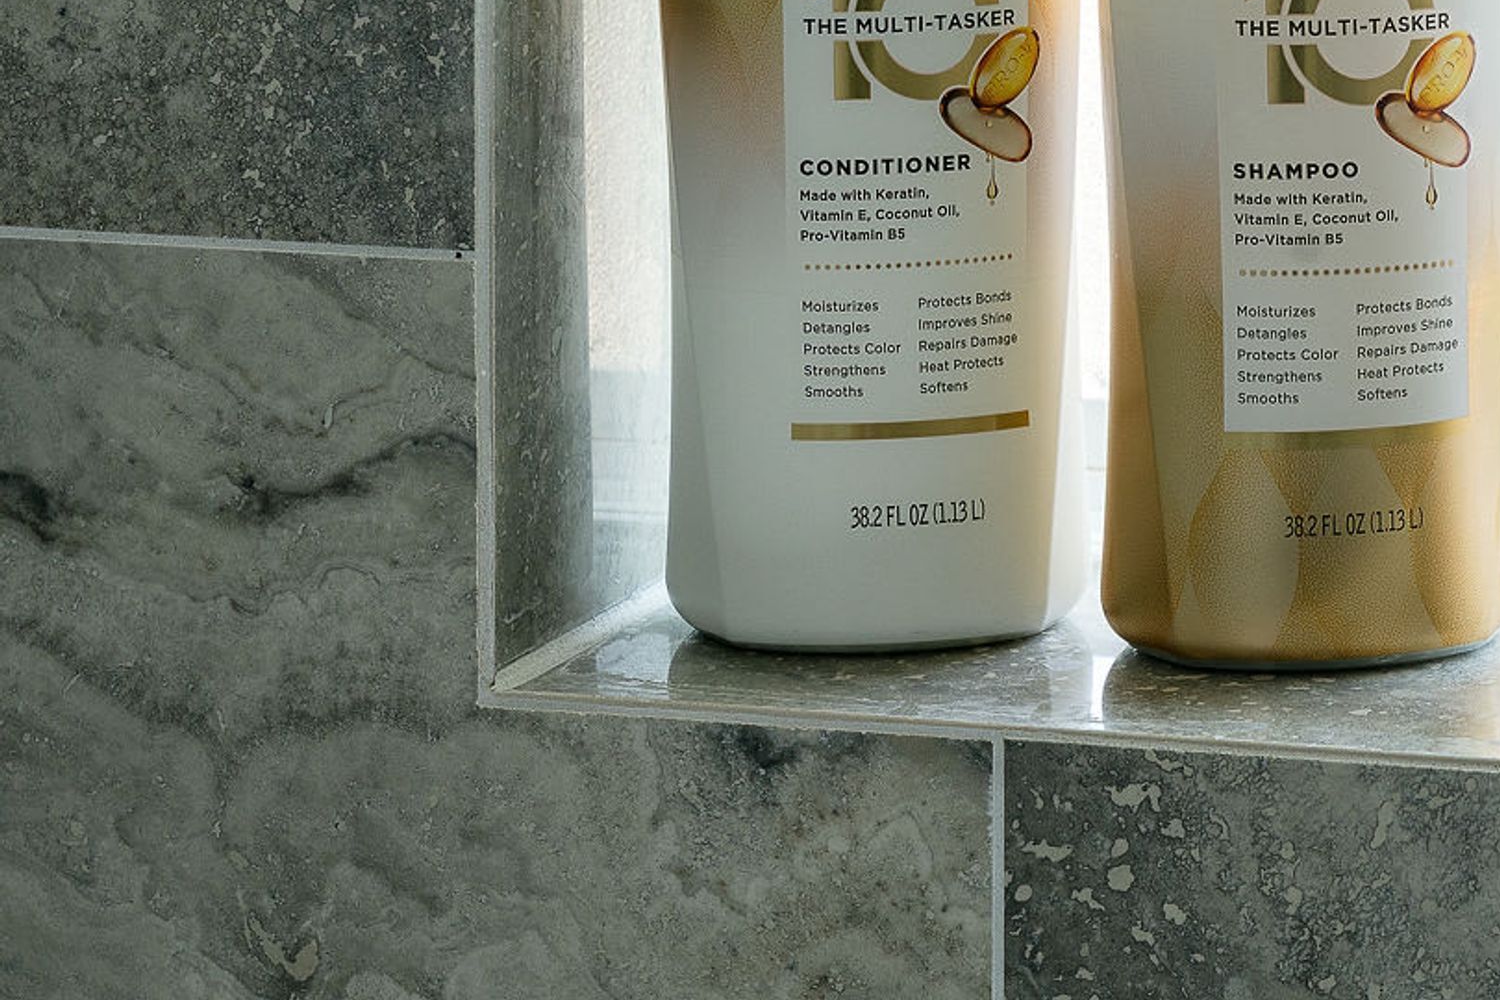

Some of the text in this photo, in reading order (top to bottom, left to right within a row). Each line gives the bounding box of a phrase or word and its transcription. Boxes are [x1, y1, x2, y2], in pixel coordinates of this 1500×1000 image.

[803, 9, 1015, 35] THE MULTI-TASKER
[1235, 13, 1449, 36] THE MULTI-TASKER
[799, 154, 971, 176] CONDITIONER
[1233, 161, 1359, 180] SHAMPOO
[799, 187, 930, 201] Made with Keratin,
[1234, 191, 1368, 205] Made with Keratin,
[799, 205, 960, 222] Vitamin E, Coconut Oil,
[1234, 210, 1399, 227] Vitamin E, Coconut Oil,
[800, 228, 905, 241] Pro-Vitamin B5
[1235, 233, 1343, 246] Pro-Vitamin B5
[801, 300, 879, 312] Moisturizes
[918, 291, 1012, 309] Protects Bonds
[1356, 296, 1453, 315] Protects Bonds
[1237, 305, 1316, 317] Moisturizes
[803, 322, 870, 335] Detangles
[918, 313, 1012, 331] Improves Shine
[1357, 318, 1453, 337] Improves Shine
[1237, 327, 1307, 341] Detangles
[804, 342, 901, 355] Protects Color
[919, 333, 1018, 352] Repairs Damage
[1357, 339, 1458, 359] Repairs Damage
[1237, 348, 1338, 361] Protects Color
[804, 364, 886, 378] Strengthens
[919, 356, 1004, 373] Heat Protects
[1357, 362, 1444, 379] Heat Protects
[1237, 371, 1322, 384] Strengthens
[805, 386, 864, 398] Smooths
[920, 381, 968, 394] Softens
[1357, 387, 1408, 400] Softens
[1237, 392, 1299, 404] Smooths
[851, 498, 985, 528] 38.2 FL OZ (1.13 L)
[1284, 507, 1424, 538] 38.2 FL OZ (1.13 L)
